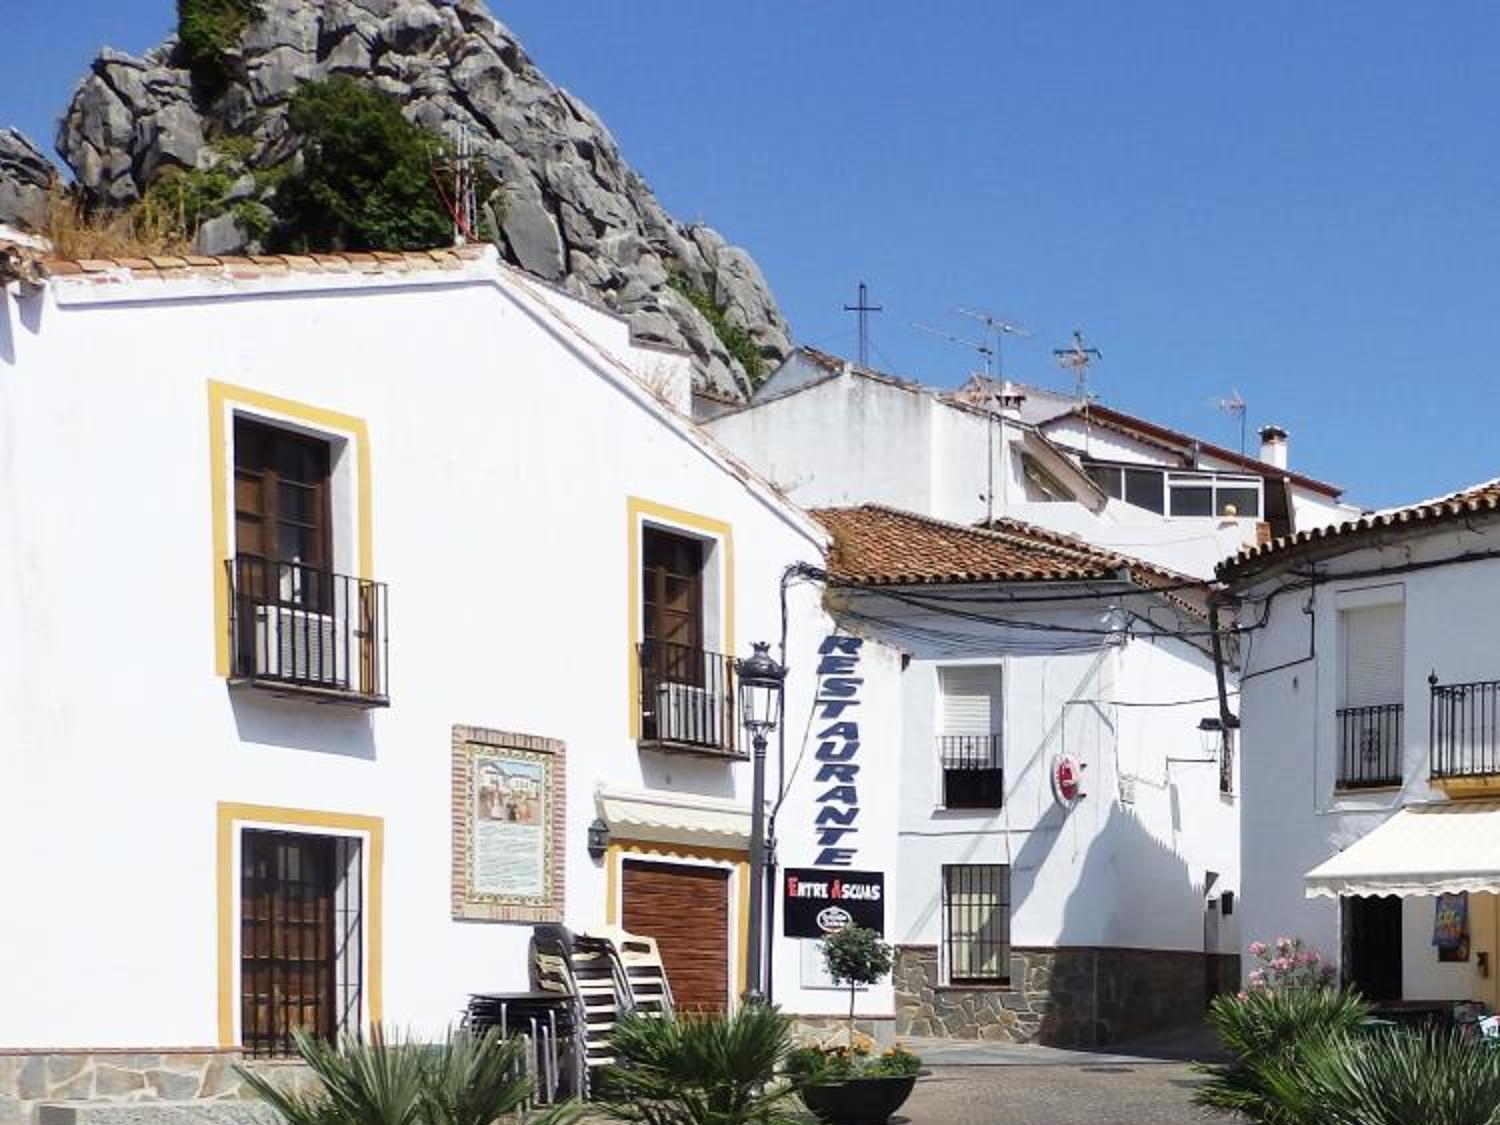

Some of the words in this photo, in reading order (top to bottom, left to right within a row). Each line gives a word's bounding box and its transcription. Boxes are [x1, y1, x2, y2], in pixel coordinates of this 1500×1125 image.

[813, 636, 864, 866] RESTAURANTE
[787, 877, 829, 898] ENTRE
[831, 879, 881, 900] ASCUAS
